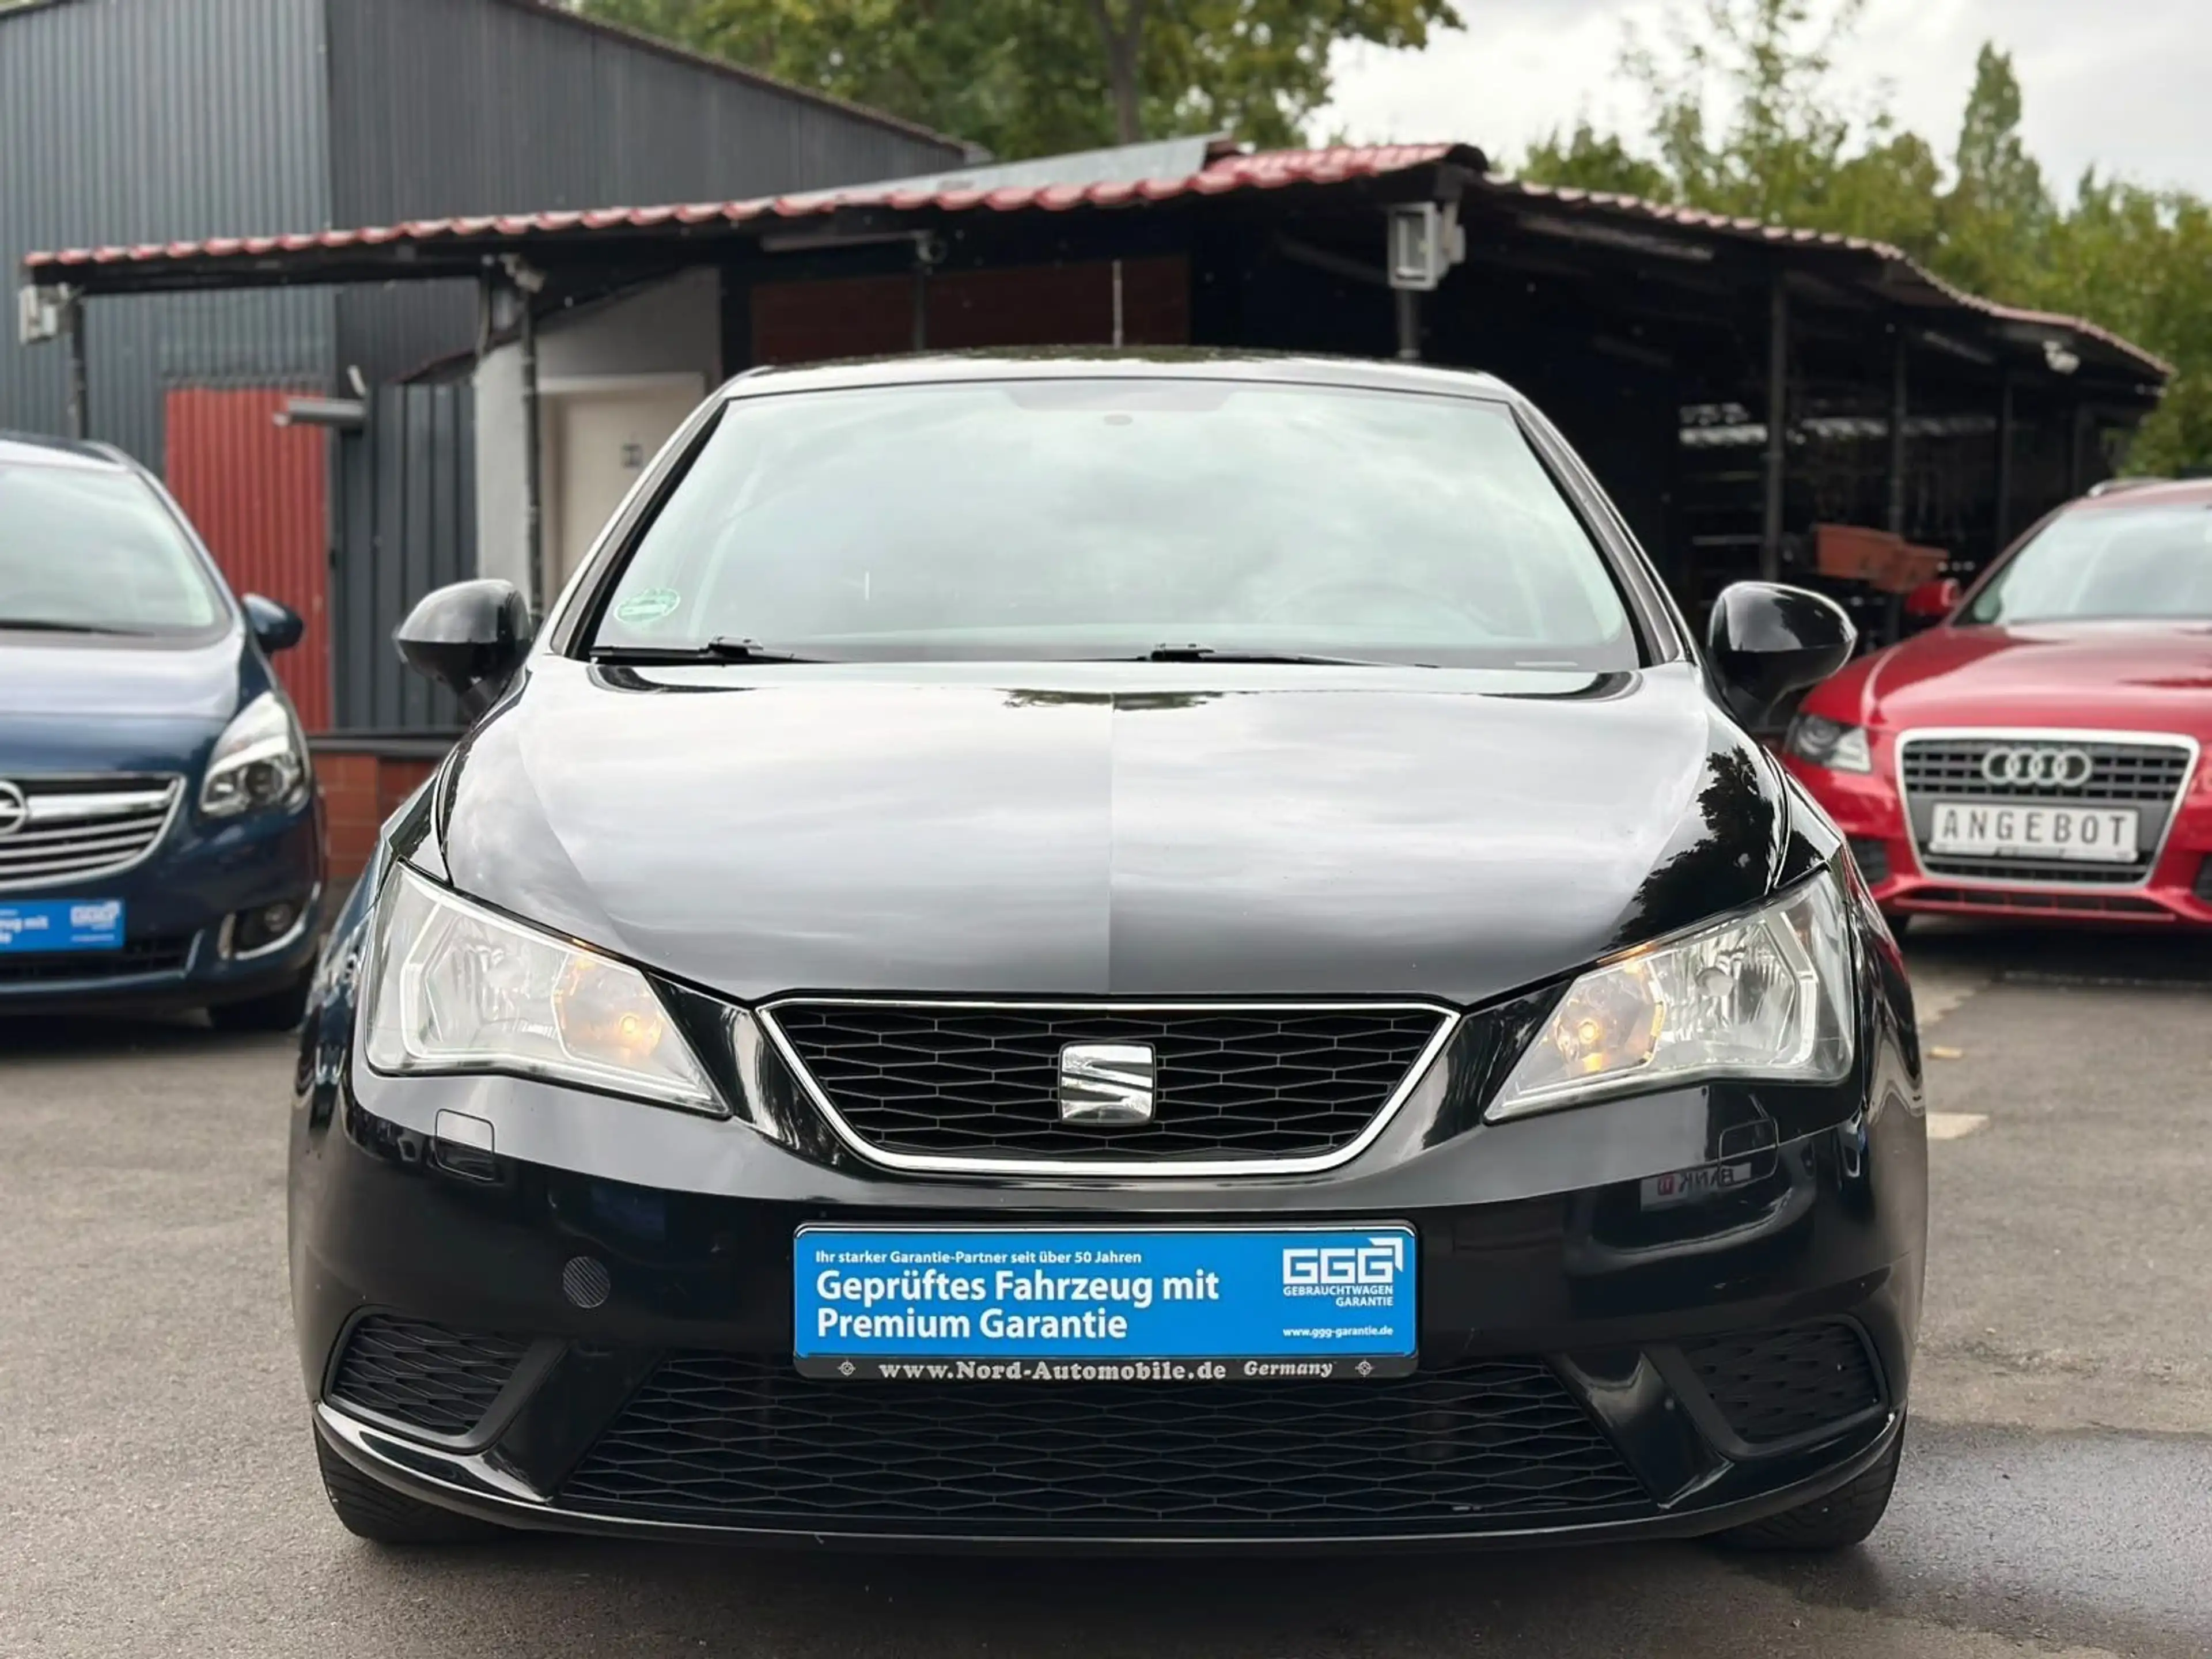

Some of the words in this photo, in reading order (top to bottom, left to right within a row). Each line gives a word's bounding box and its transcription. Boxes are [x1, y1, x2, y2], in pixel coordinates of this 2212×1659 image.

[1941, 809, 2126, 845] ANGEBOT
[816, 1250, 835, 1263] Ihr
[838, 1251, 887, 1263] starker
[890, 1251, 1007, 1263] Garantie-Partner
[1011, 1251, 1036, 1263] seit
[1039, 1251, 1071, 1263] über
[1074, 1251, 1092, 1263] 50
[1094, 1251, 1142, 1263] Jahren
[1283, 1248, 1393, 1284] GGG
[817, 1268, 986, 1307] Geprüftes
[994, 1269, 1153, 1308] Fahrzeug
[1162, 1269, 1219, 1300] mit
[1283, 1285, 1393, 1296] GEBRAUCHTWAGEN
[1335, 1296, 1393, 1306] GARANTIE
[817, 1308, 970, 1338] Premium
[979, 1308, 1128, 1338] Garantie
[1282, 1325, 1393, 1338] www.ggg-garantie.de
[878, 1361, 1226, 1380] www.Nord-Automobile.de
[1243, 1360, 1333, 1377] Germany
